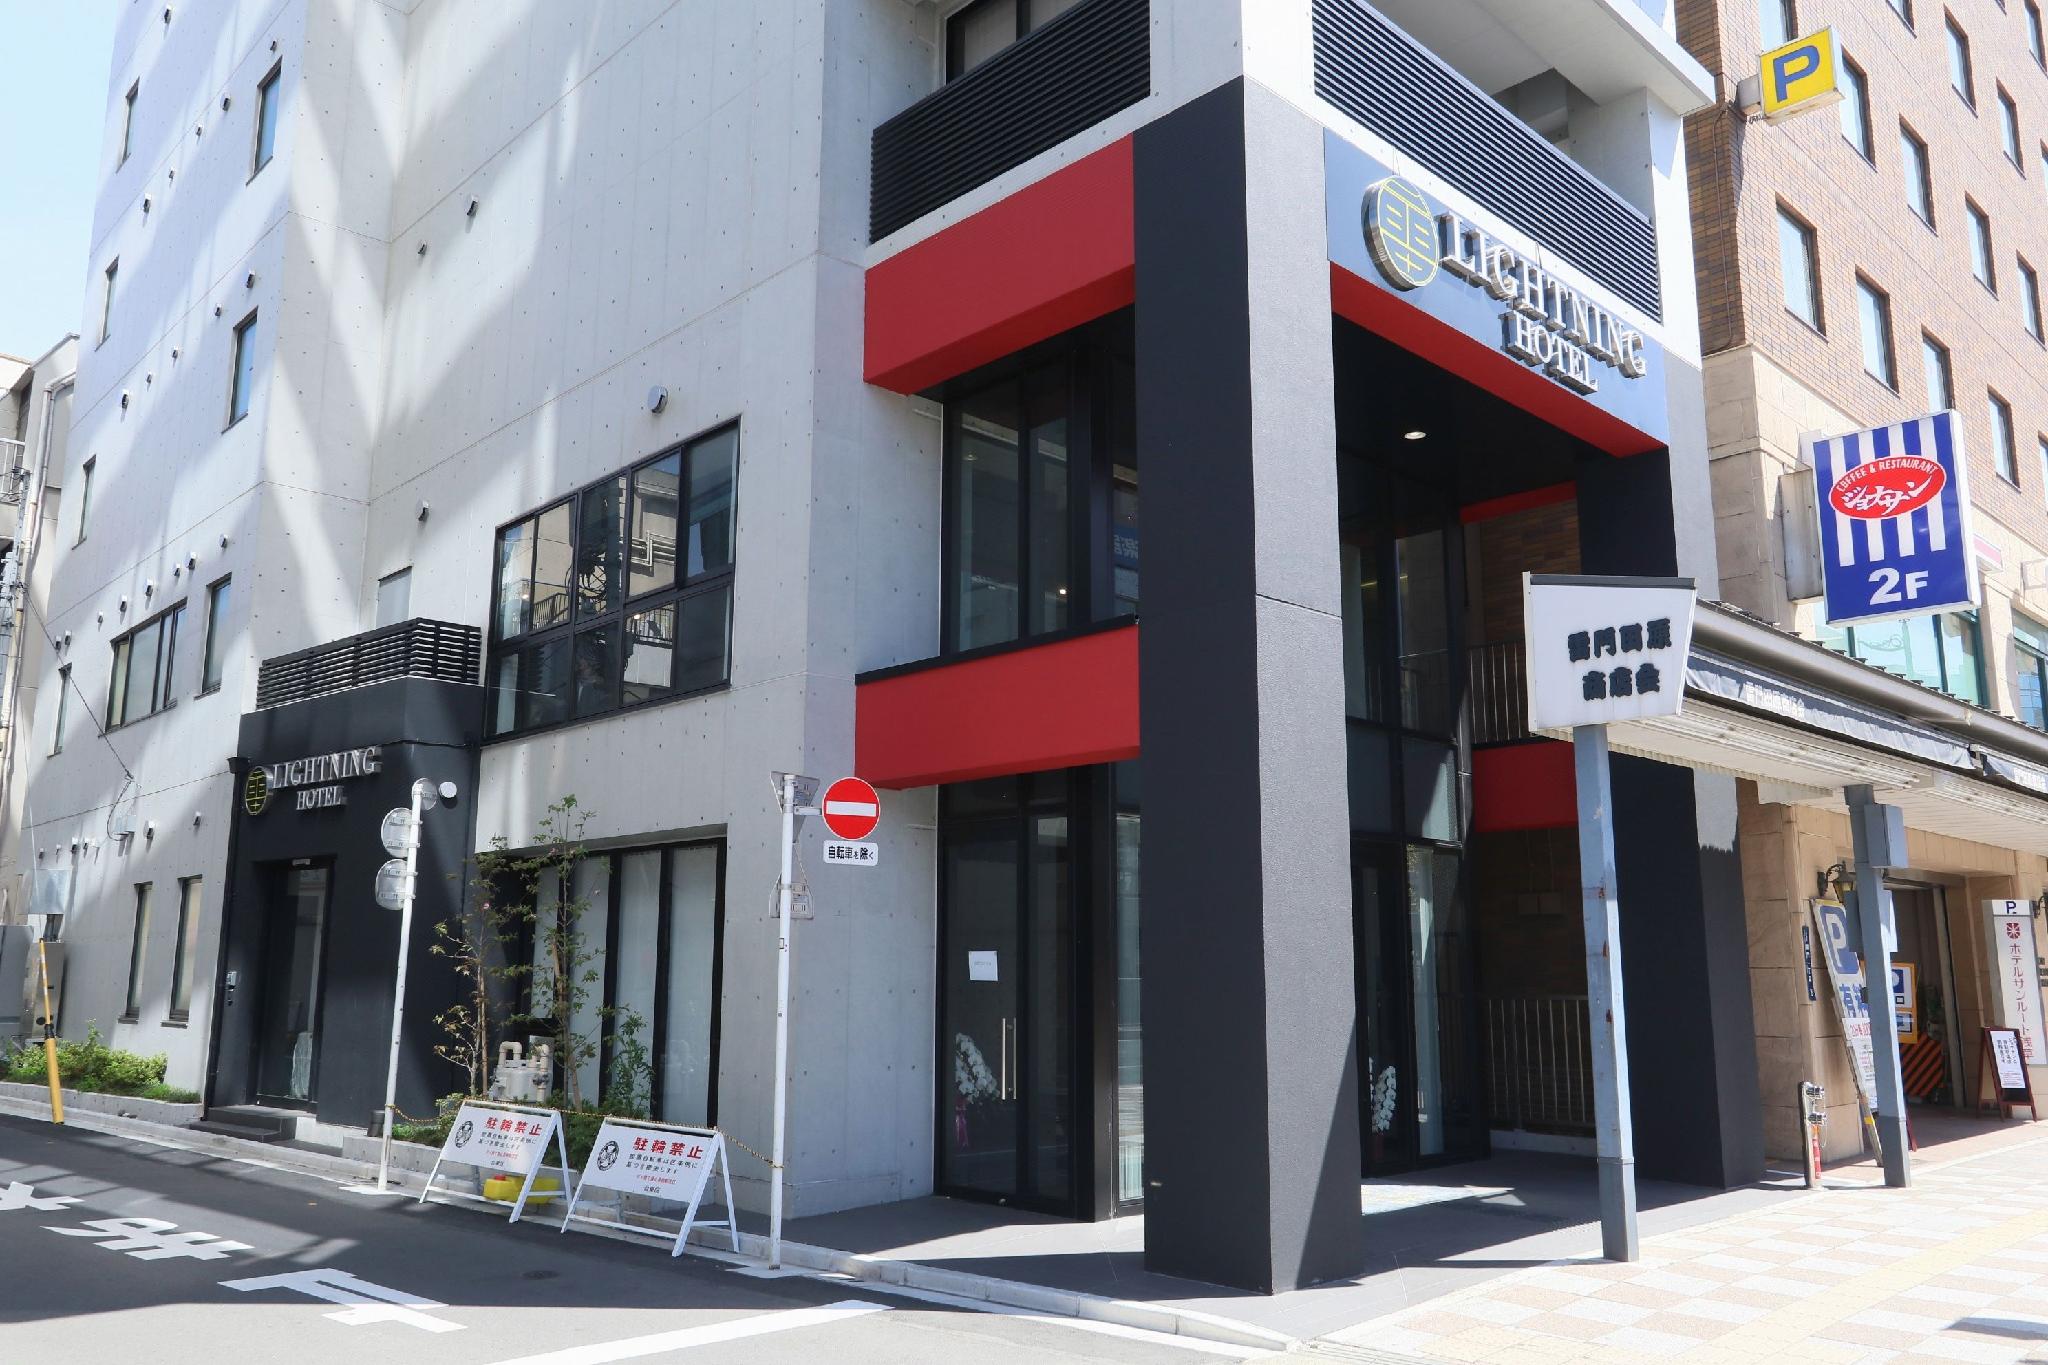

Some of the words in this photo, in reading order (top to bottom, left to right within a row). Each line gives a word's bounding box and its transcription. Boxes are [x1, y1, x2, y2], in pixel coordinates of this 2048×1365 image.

[1772, 44, 1820, 103] P
[1436, 211, 1646, 378] LIGHTNING
[1499, 311, 1598, 395] HOTEL
[1837, 465, 1867, 493] COFFEE
[1869, 464, 1876, 474] &
[1879, 457, 1937, 475] RESTAURANT
[1868, 567, 1928, 605] 2F
[272, 746, 380, 789] LIGHTNING
[296, 785, 344, 810] HOTEL
[828, 846, 874, 860] 自転車を除く
[2006, 900, 2017, 914] P
[485, 1117, 542, 1136] 駐輪禁止
[632, 1136, 703, 1159] 駐輪禁止
